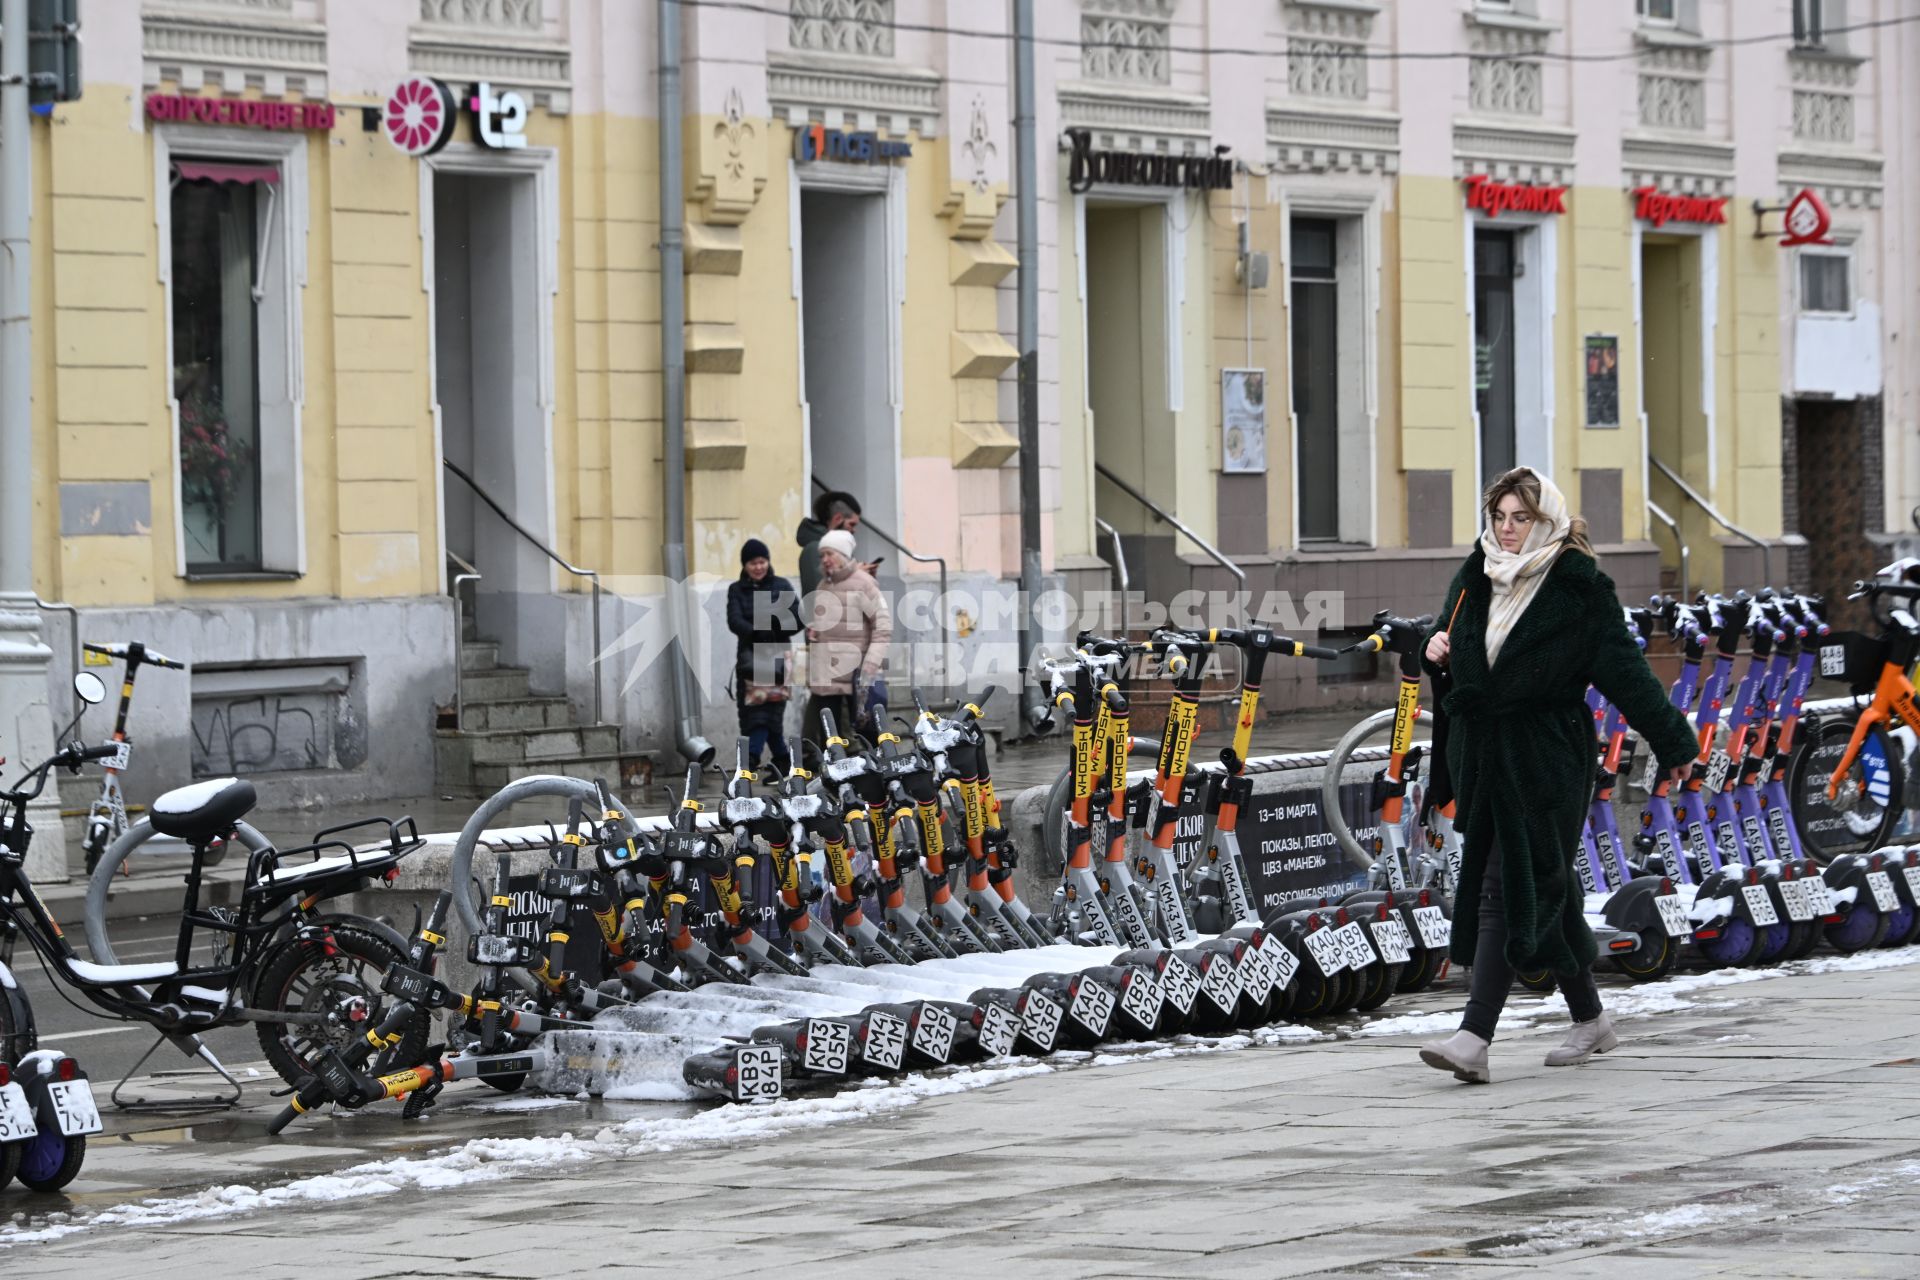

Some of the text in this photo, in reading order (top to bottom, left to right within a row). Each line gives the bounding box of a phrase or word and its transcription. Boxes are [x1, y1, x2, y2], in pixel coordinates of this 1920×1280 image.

[1464, 175, 1567, 217] Теремок
[1633, 186, 1728, 227] Теремок
[1113, 722, 1125, 789] WHOOSH
[1172, 707, 1194, 774] WHOOSH
[1077, 731, 1089, 797] WHOOSH
[924, 809, 939, 855] WHOOSH
[967, 786, 980, 836] WHOOSH
[1287, 803, 1317, 819] МАРТА
[1262, 836, 1304, 854] ПОКАЗЫ,
[1263, 854, 1327, 877] ЦВЗ «МАНЕЖ»
